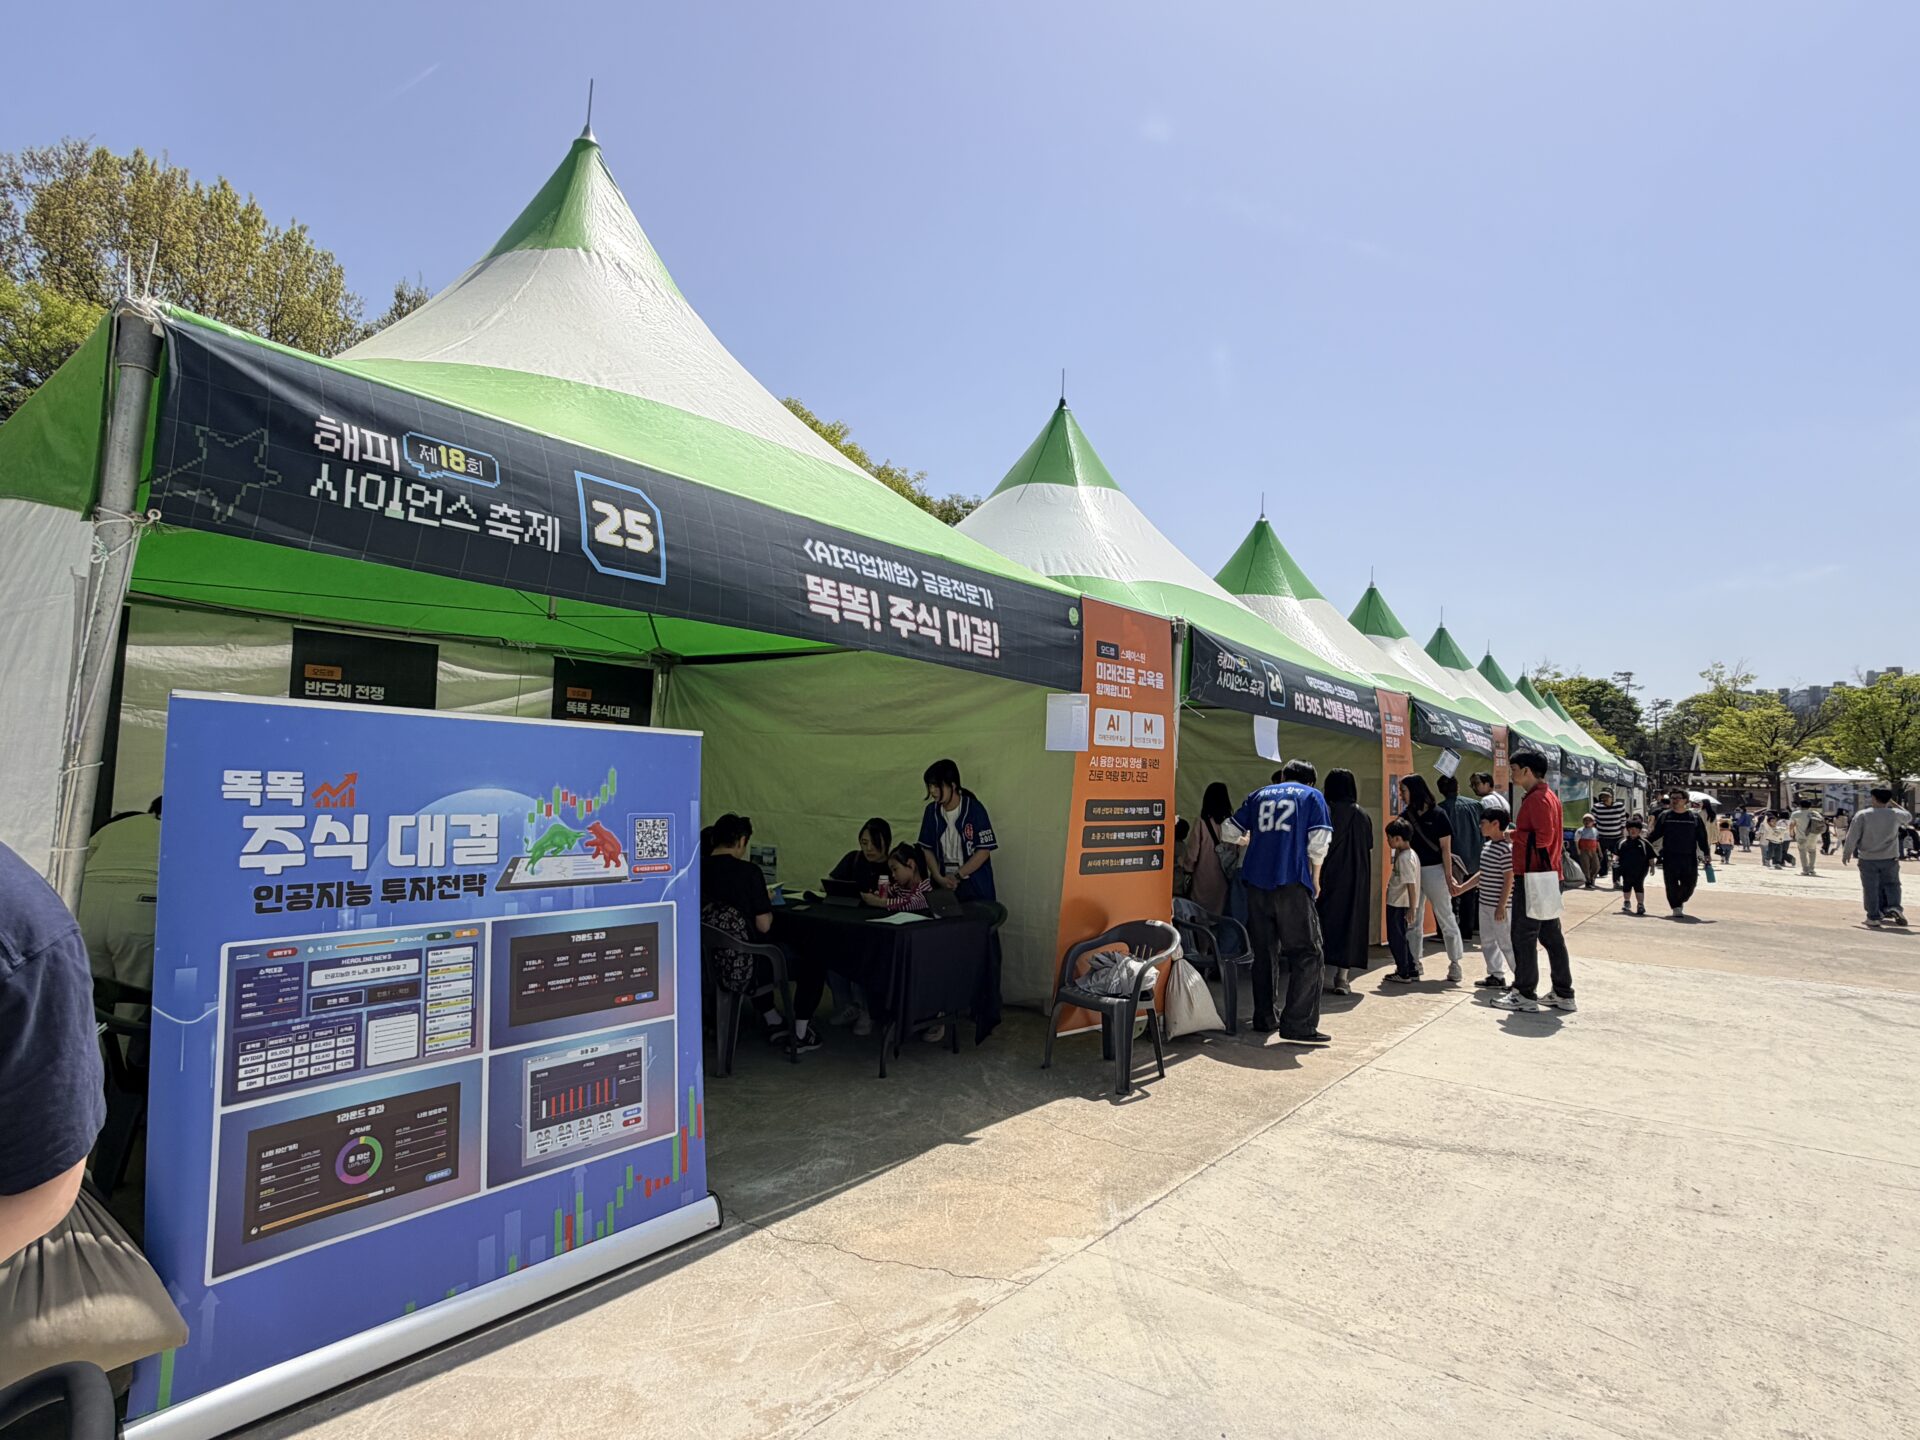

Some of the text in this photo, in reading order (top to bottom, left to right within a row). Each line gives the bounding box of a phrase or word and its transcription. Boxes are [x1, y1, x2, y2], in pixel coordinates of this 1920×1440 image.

[314, 414, 483, 476] 해피 제18회
[310, 463, 560, 553] 사이언스 축제
[592, 500, 654, 553] 25
[921, 570, 994, 610] 금융전문가
[806, 573, 1000, 659] 똑똑! 주식 대결!
[305, 681, 384, 700] 반도체 전쟁
[1096, 662, 1164, 690] 미래진로 교육을
[566, 701, 630, 718] 똑똑 주식대결
[1107, 714, 1120, 731] AI
[1144, 718, 1153, 734] M
[1088, 770, 1104, 782] 진로
[1136, 772, 1148, 782] 진단
[1090, 756, 1098, 767] AI
[221, 770, 305, 807] 똑똑
[1258, 800, 1295, 832] 82
[239, 814, 499, 876] 주식 대결
[253, 873, 487, 914] 인공지능 투자전략
